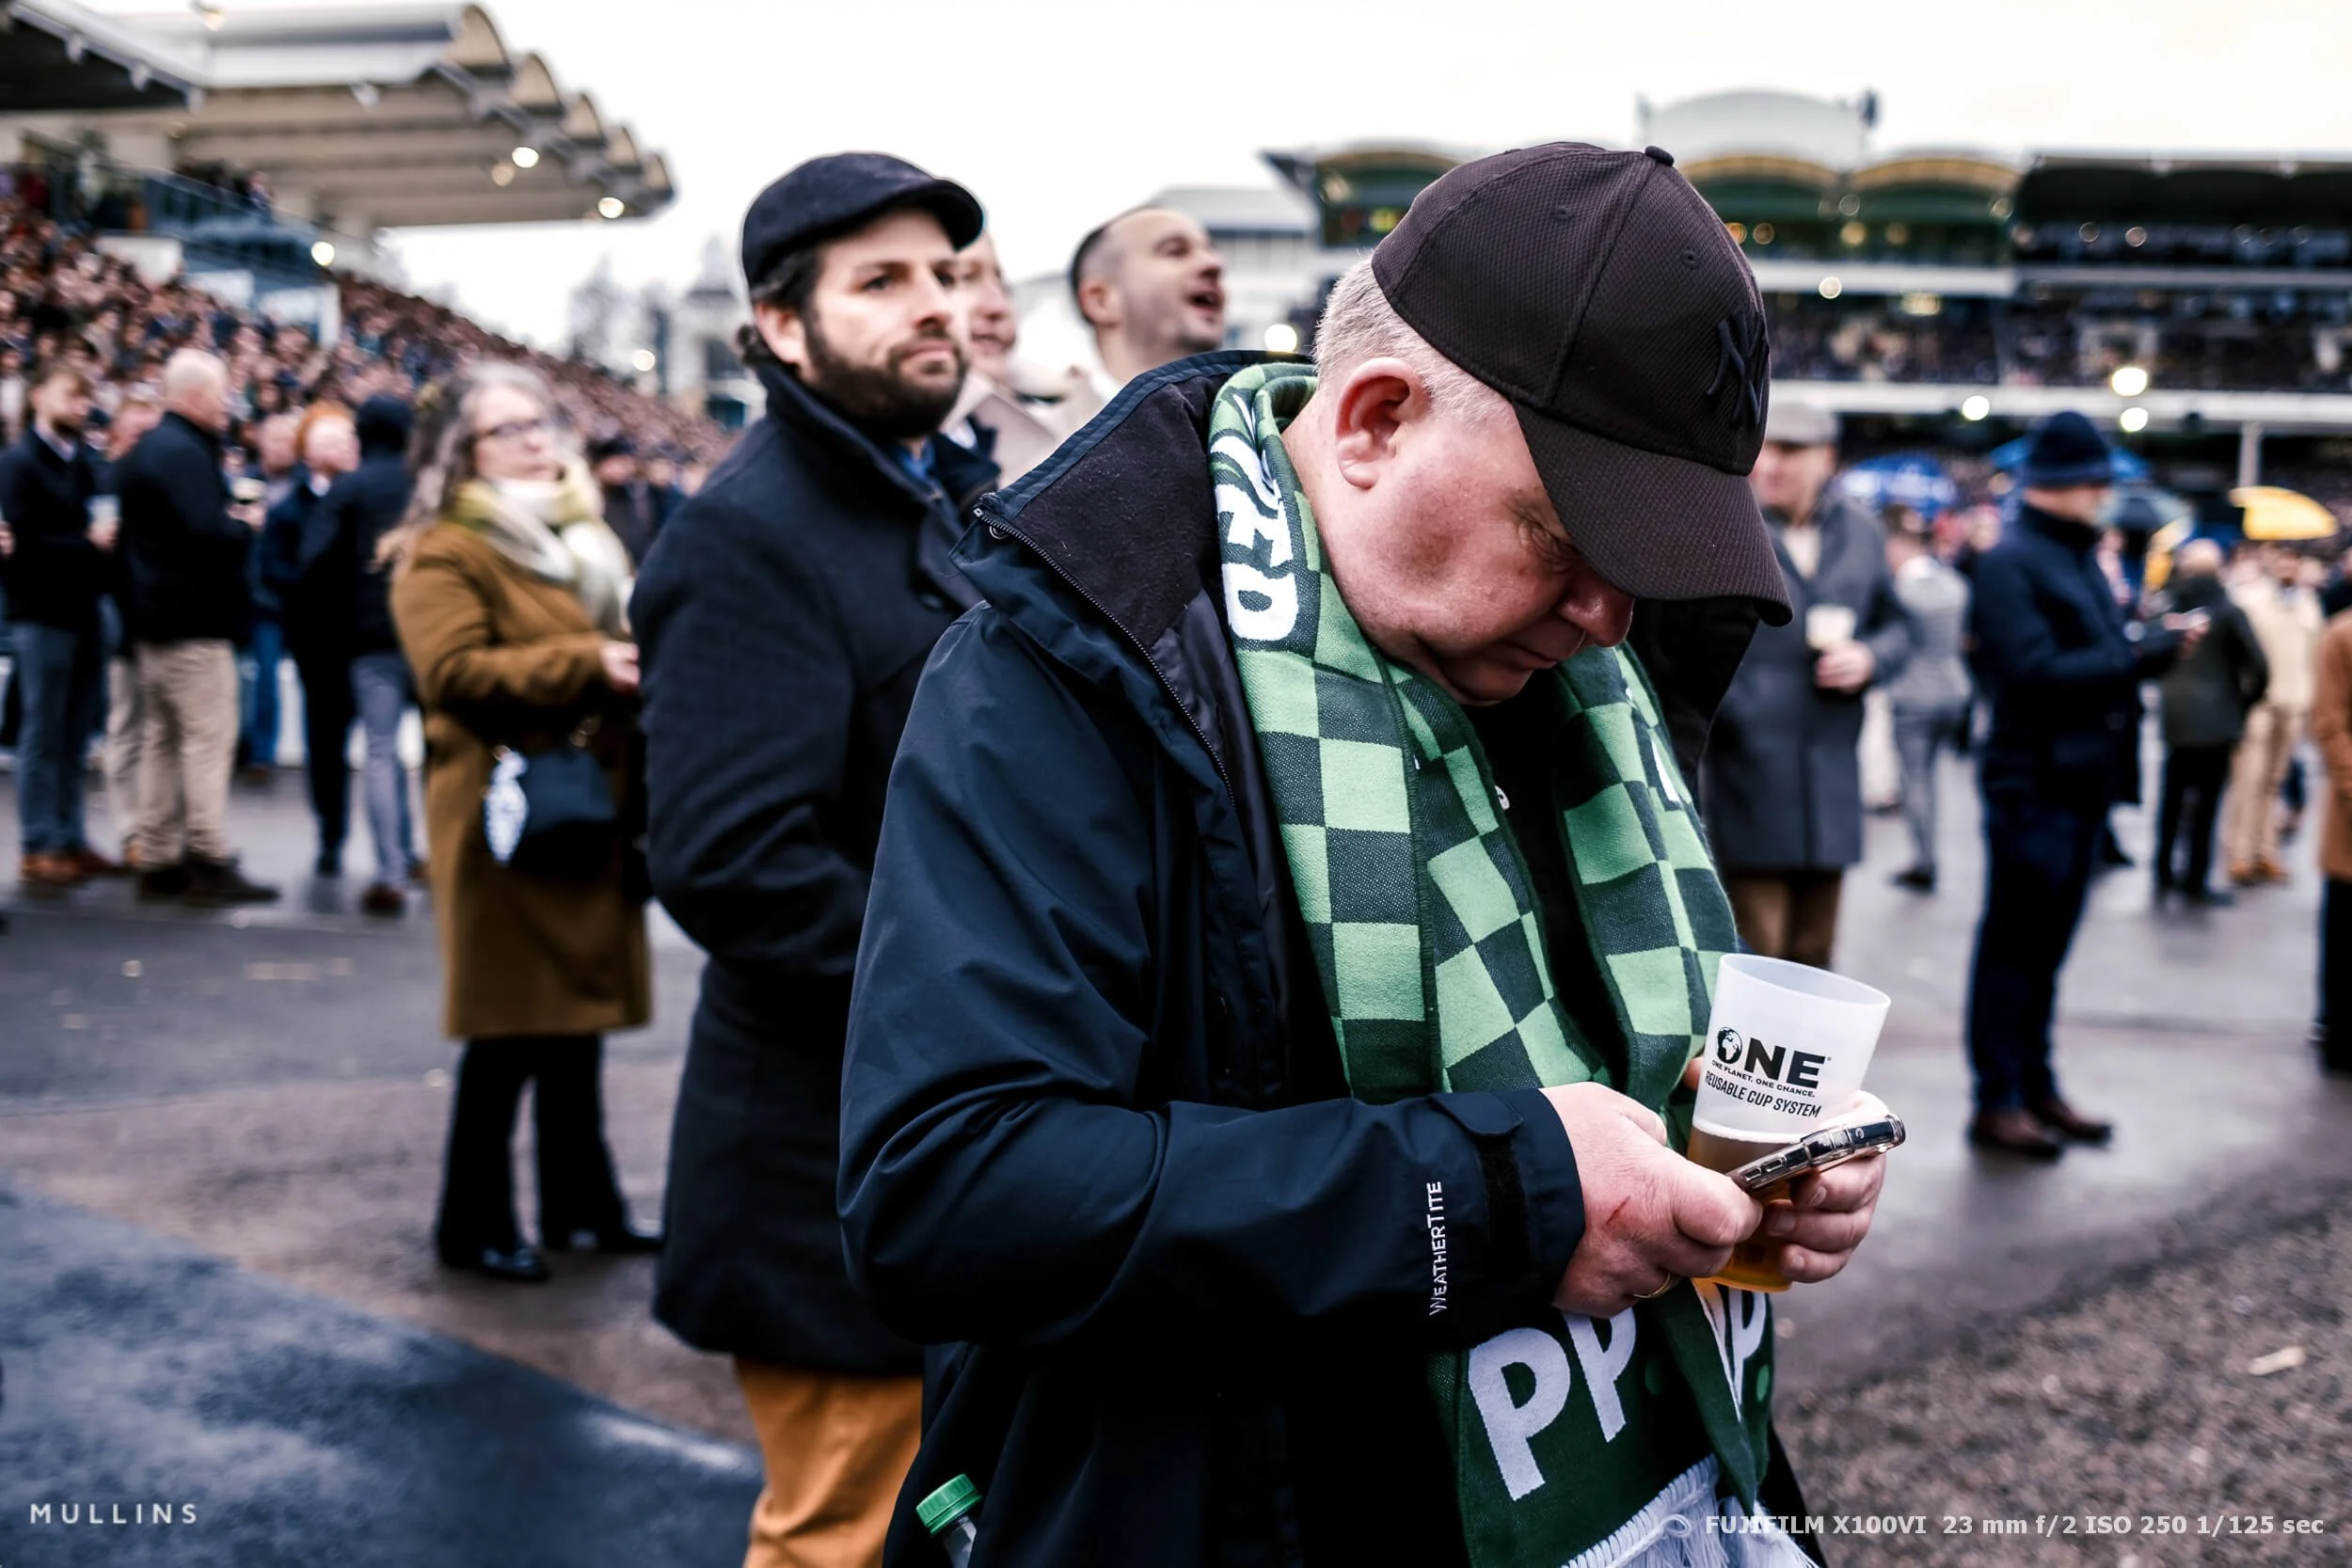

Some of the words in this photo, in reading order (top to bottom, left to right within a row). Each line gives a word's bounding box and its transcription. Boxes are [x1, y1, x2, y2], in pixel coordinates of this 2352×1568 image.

[1711, 1059, 1724, 1070] ONE
[1724, 1068, 1754, 1083] PLANET.
[1756, 1078, 1775, 1089] ONE
[1776, 1084, 1816, 1098] CHANCE.
[1747, 1090, 1773, 1107] CUP
[1773, 1098, 1822, 1118] SYSTEM
[1426, 1181, 1448, 1316] WEATHERTITE
